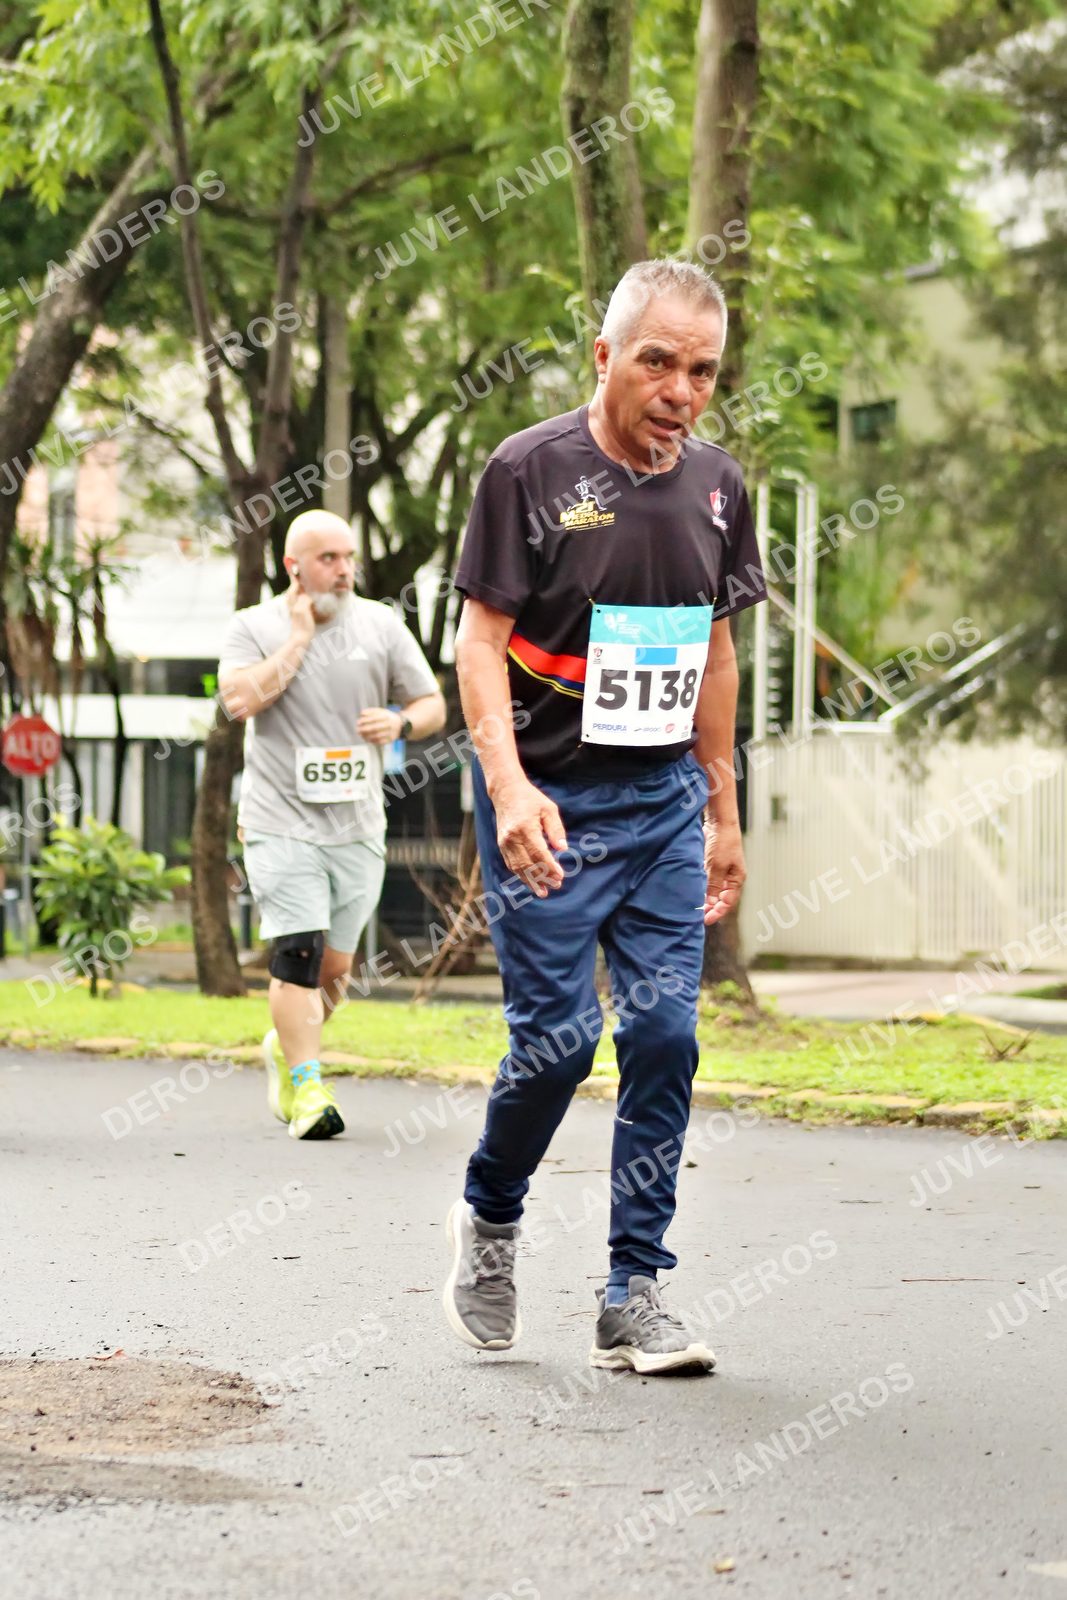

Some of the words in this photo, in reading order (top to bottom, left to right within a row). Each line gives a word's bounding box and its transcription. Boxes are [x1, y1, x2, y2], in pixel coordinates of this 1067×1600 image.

[595, 669, 697, 711] 5138
[4, 731, 57, 760] ALTO
[303, 760, 366, 782] 6592
